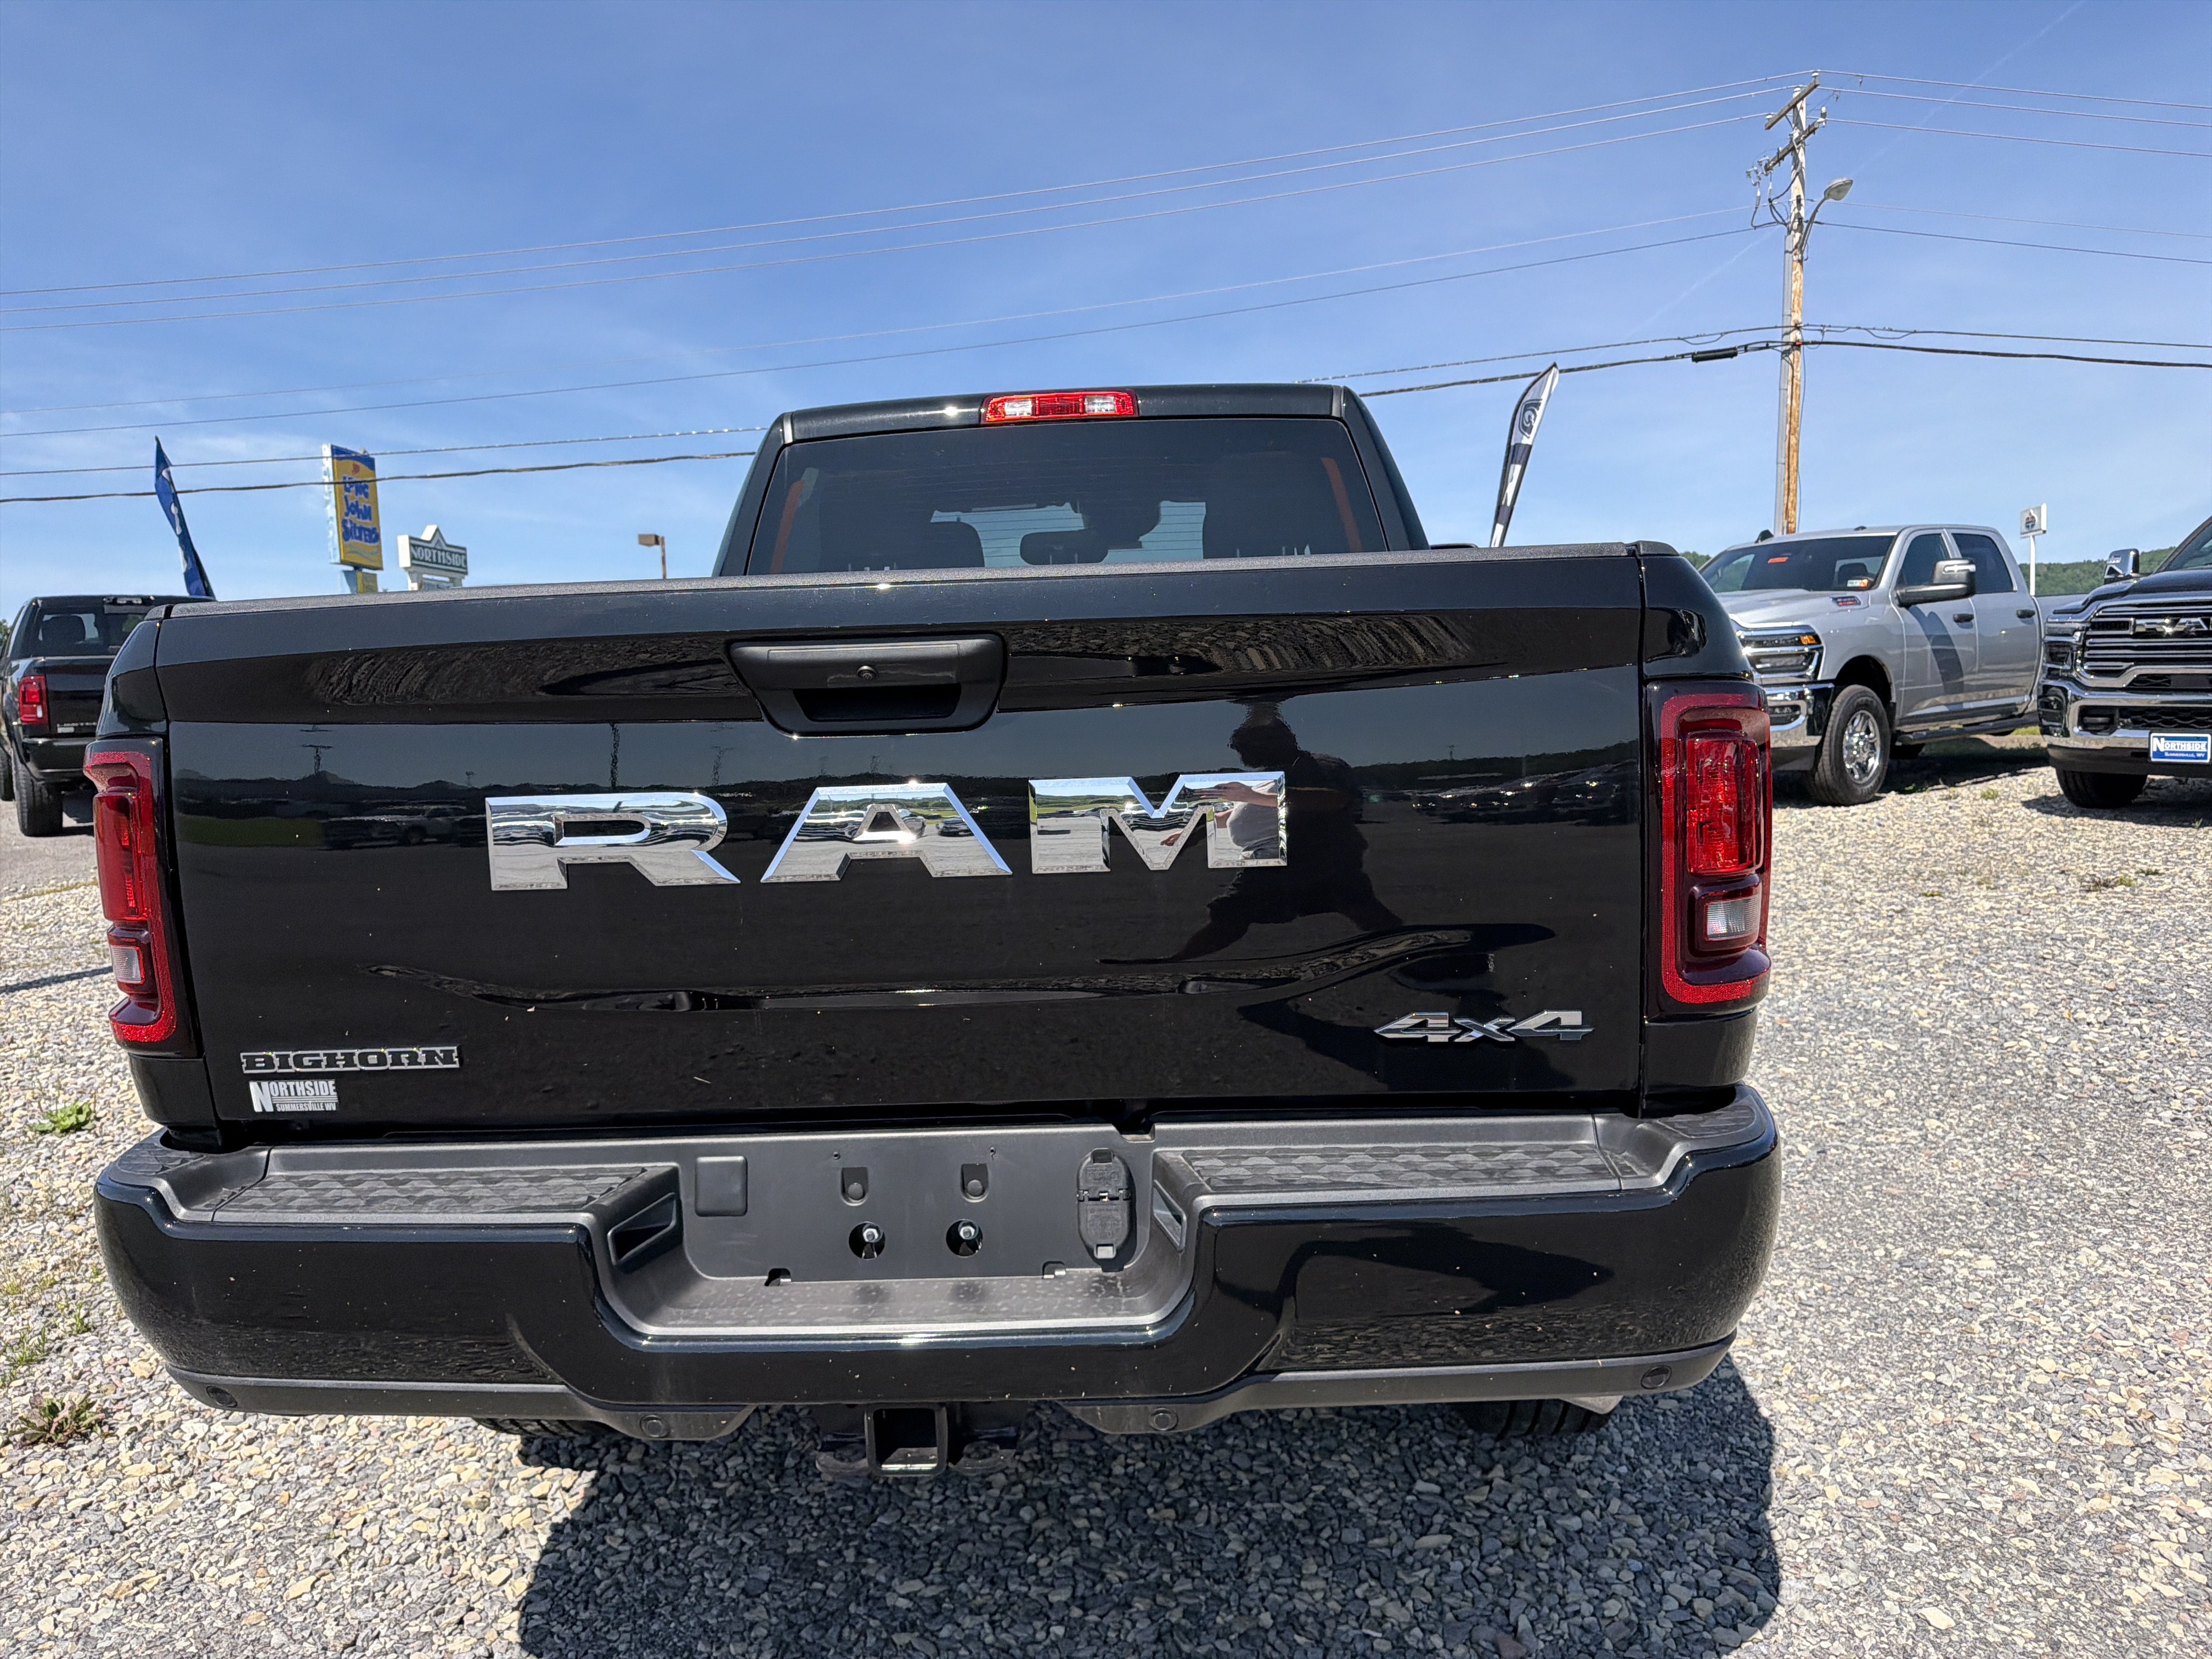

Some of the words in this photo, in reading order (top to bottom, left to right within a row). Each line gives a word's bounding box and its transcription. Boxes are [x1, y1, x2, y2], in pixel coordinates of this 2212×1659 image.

[410, 545, 466, 567] NORTHSIDE
[2153, 737, 2207, 752] NORTHSIDE
[485, 771, 1287, 890] RAM
[240, 1046, 460, 1074] BIGHORN
[249, 1080, 337, 1112] NORTHSIDE
[276, 1103, 325, 1111] SUMMERSVILLE
[325, 1102, 336, 1111] WV
